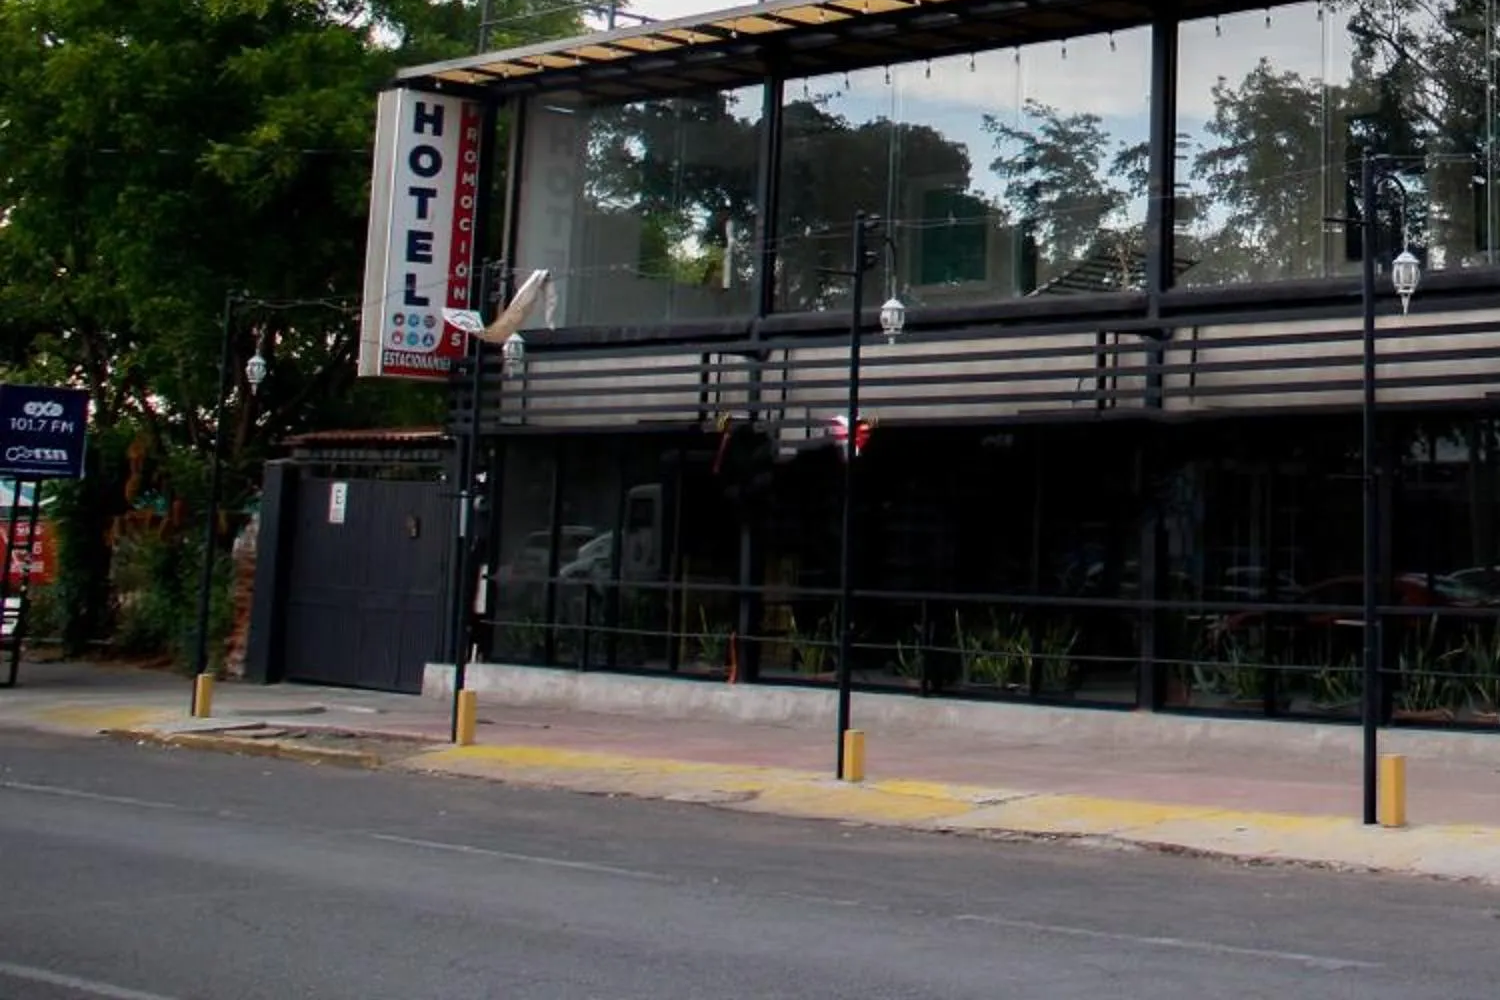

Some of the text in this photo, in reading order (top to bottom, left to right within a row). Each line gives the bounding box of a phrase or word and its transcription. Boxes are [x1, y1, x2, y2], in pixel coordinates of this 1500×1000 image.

[404, 101, 445, 307] HOTEL
[10, 417, 75, 433] 101.7 FM
